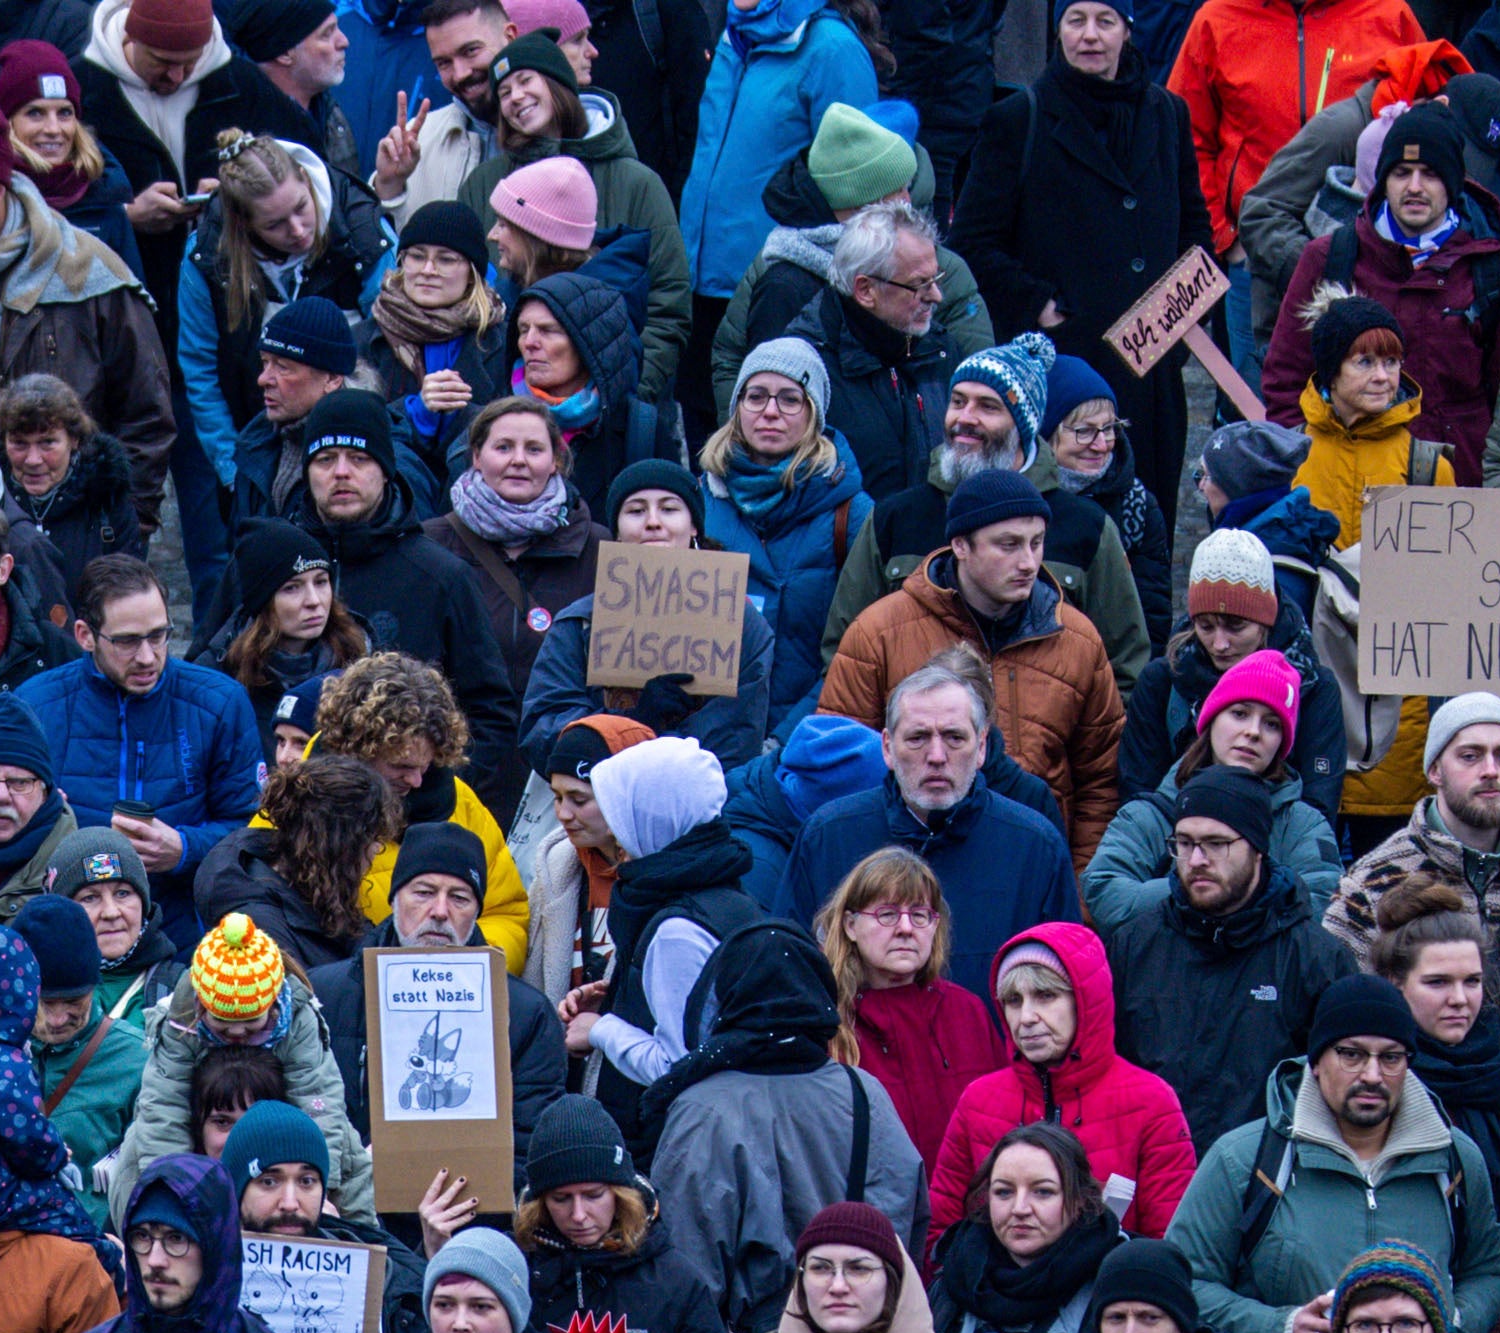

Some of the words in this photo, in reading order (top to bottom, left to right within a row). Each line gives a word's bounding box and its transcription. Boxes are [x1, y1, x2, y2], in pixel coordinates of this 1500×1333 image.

[1122, 317, 1159, 365] geh
[1157, 252, 1217, 333] wählen!
[1372, 500, 1477, 554] WER
[600, 556, 740, 623] SMASH
[592, 625, 736, 680] FASCISM
[1372, 621, 1448, 678] HAT
[392, 992, 428, 1003] statt
[436, 988, 475, 1003] Nazis
[412, 968, 453, 982] Kekse
[281, 1245, 351, 1275] RACISM
